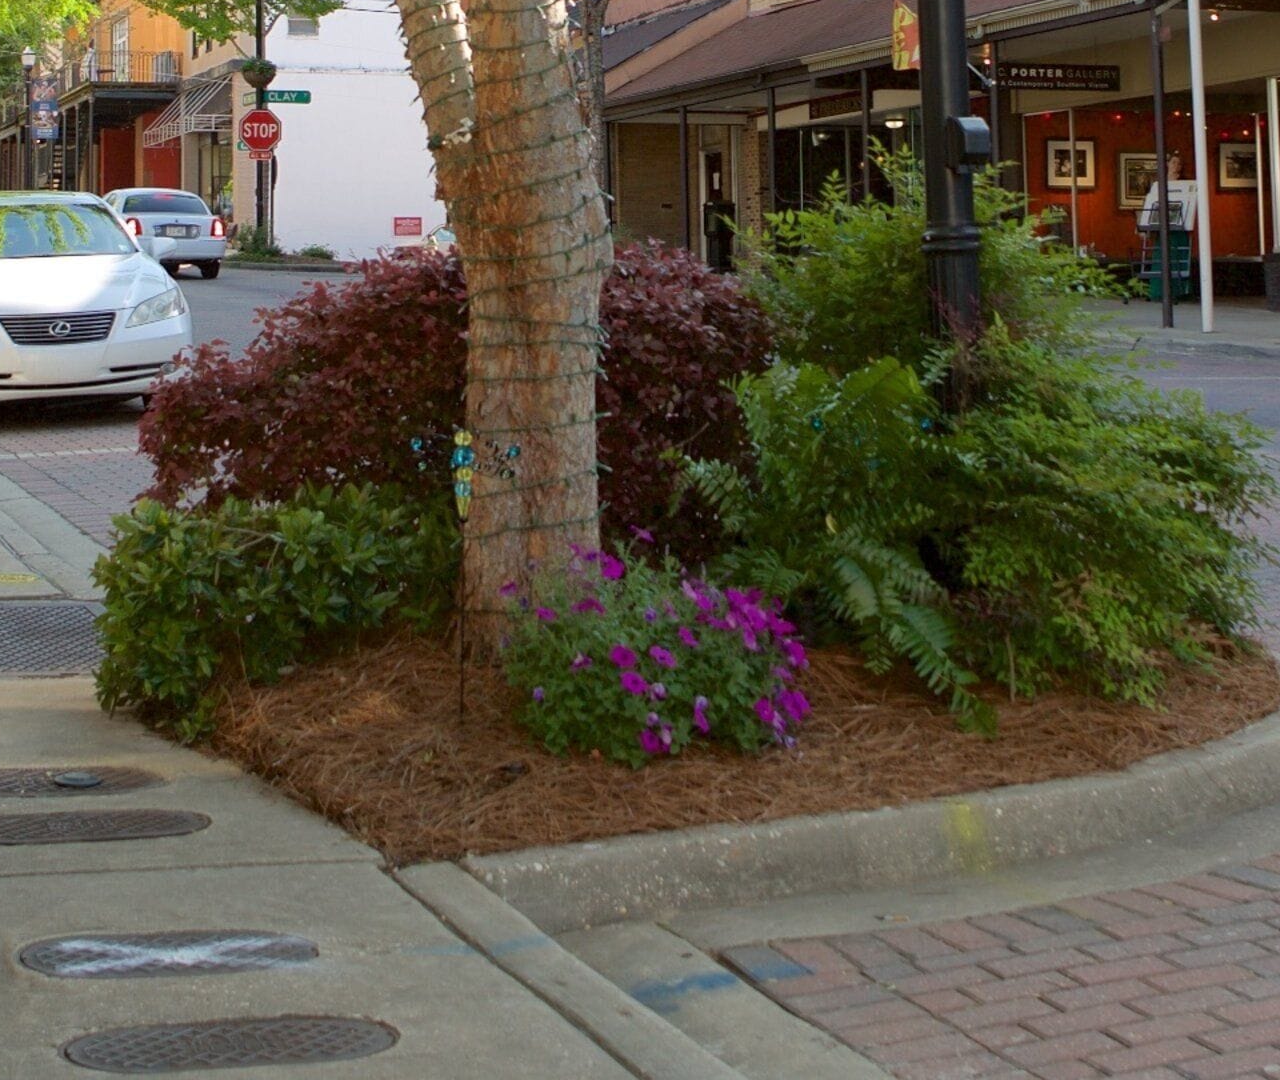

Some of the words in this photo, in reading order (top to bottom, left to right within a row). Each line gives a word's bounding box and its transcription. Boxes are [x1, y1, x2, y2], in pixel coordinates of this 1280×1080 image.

[1011, 67, 1063, 78] PORTER
[1066, 69, 1118, 79] GALLERY
[268, 92, 297, 101] CLAY
[243, 123, 277, 138] STOP
